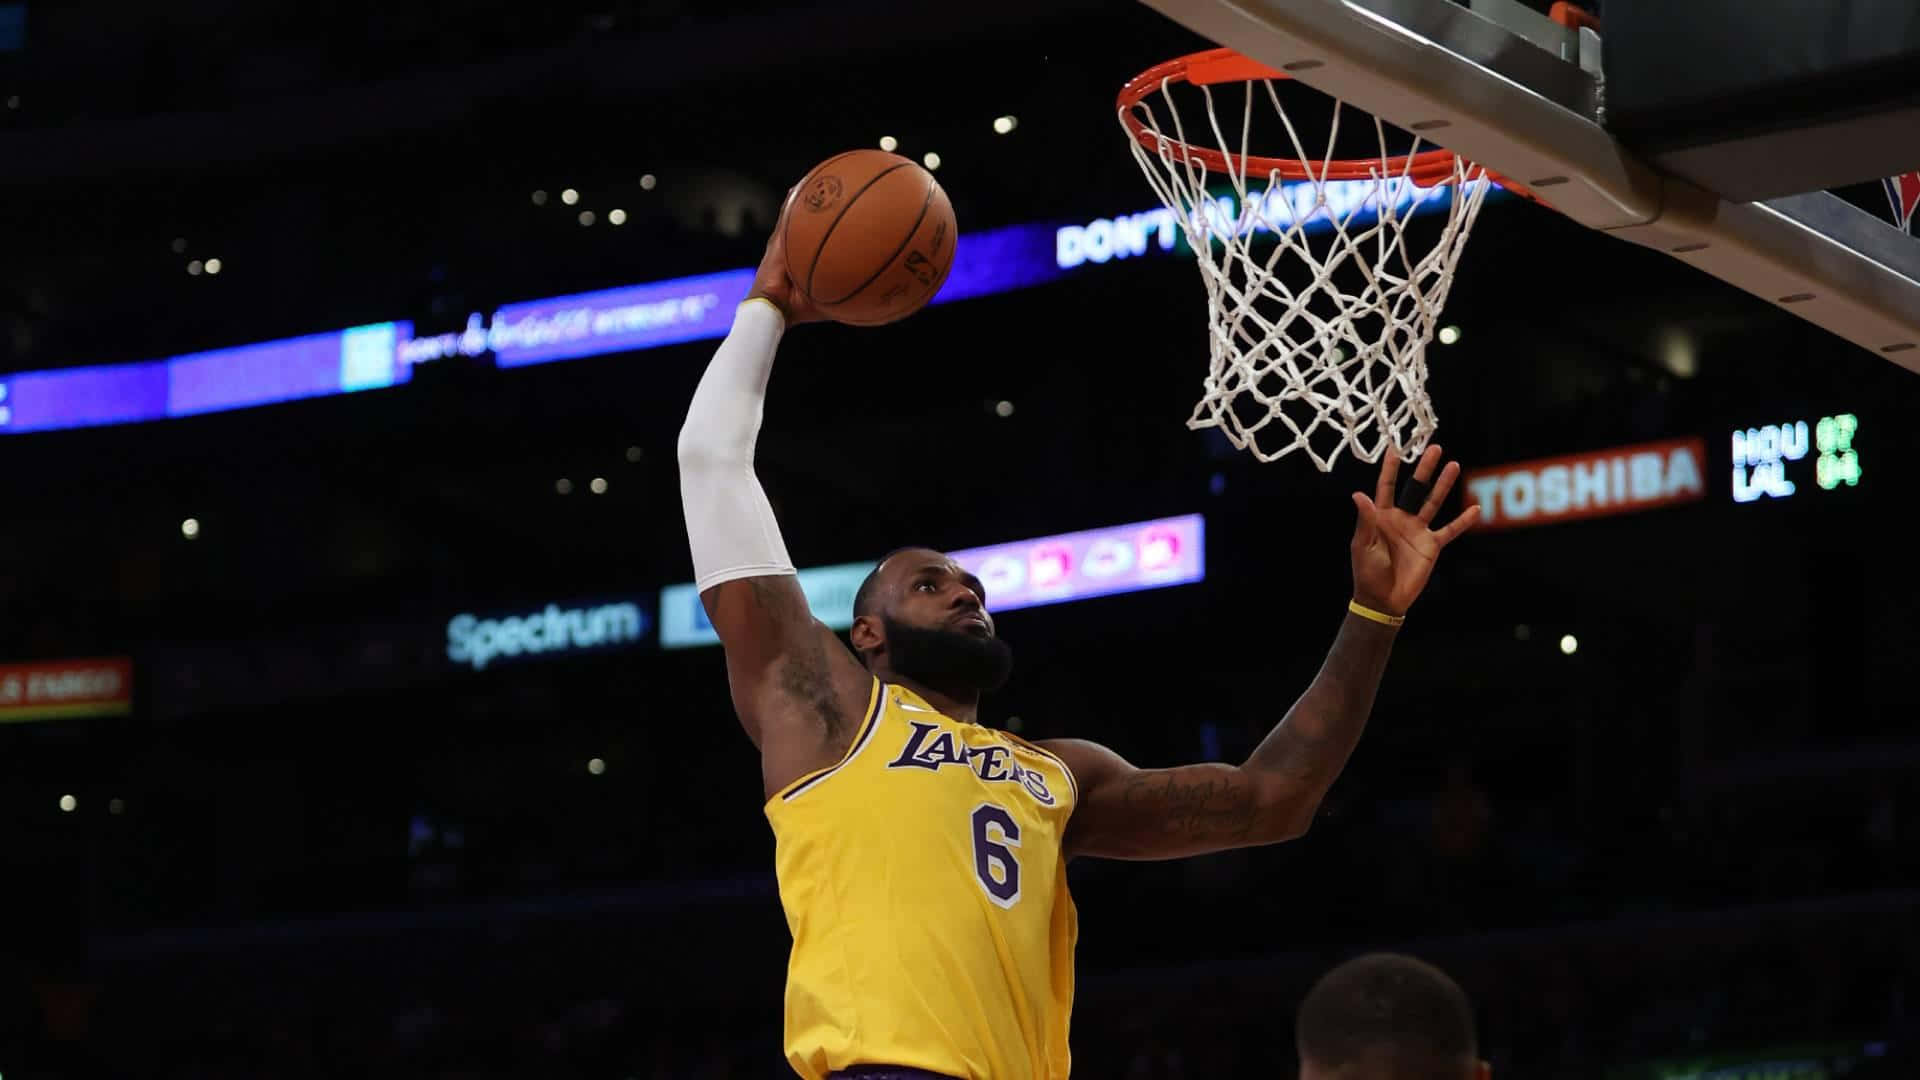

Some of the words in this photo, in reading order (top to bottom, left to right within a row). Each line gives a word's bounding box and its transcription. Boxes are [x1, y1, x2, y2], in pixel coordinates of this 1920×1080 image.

[1055, 205, 1177, 269] DON'T
[1469, 446, 1704, 524] TOSHIBA
[1732, 461, 1797, 503] LAL
[447, 602, 641, 672] Spectrum
[886, 719, 1057, 808] LAES
[970, 802, 1022, 910] 6
